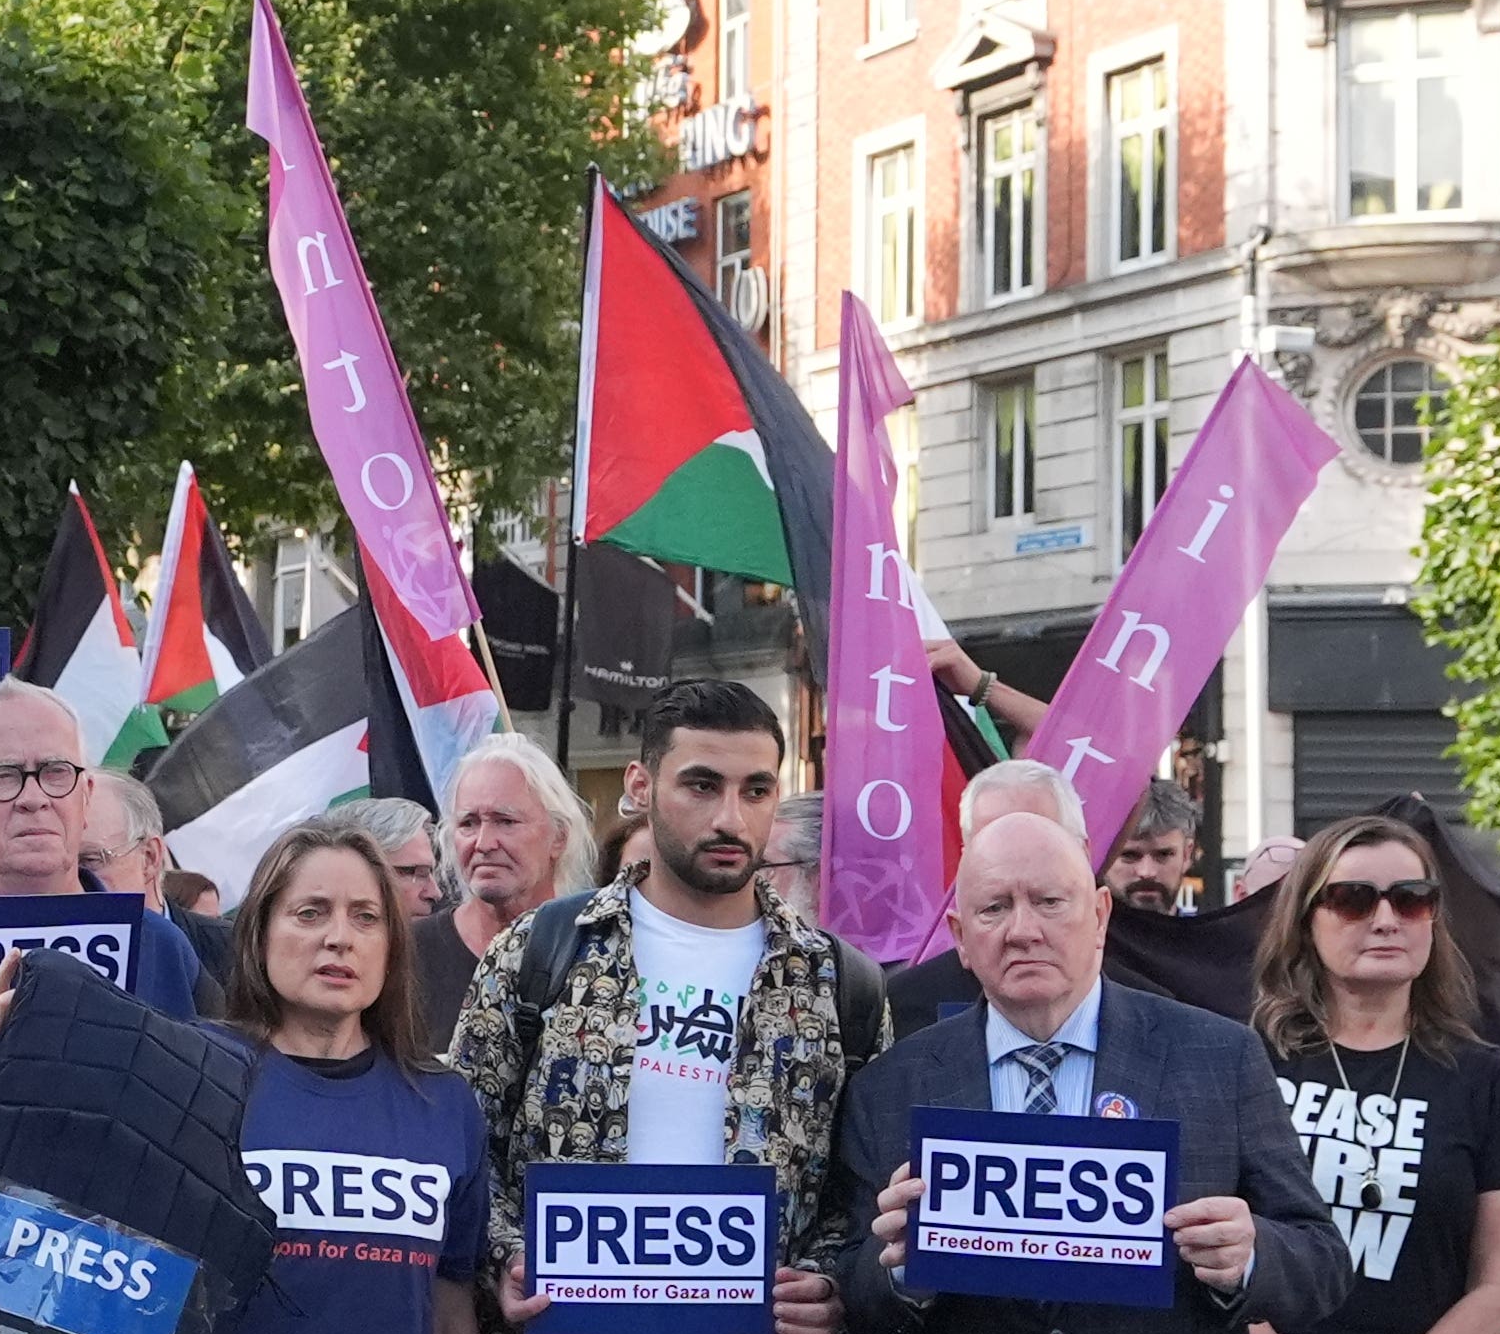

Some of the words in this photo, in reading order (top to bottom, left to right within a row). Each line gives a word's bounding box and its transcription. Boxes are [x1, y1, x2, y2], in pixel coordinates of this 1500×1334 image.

[929, 1151, 1154, 1225] PRESS
[319, 1240, 348, 1259] for
[355, 1243, 402, 1263] Gaza
[545, 1205, 756, 1266] PRESS
[927, 1232, 1013, 1253] Freedom
[1021, 1238, 1048, 1255] for
[1055, 1241, 1104, 1259] Gaza
[1111, 1247, 1152, 1261] now
[5, 1218, 158, 1301] PRESS
[545, 1283, 626, 1299] Freedom
[633, 1284, 659, 1299] for
[665, 1284, 710, 1299] Gaza
[717, 1287, 755, 1299] now
